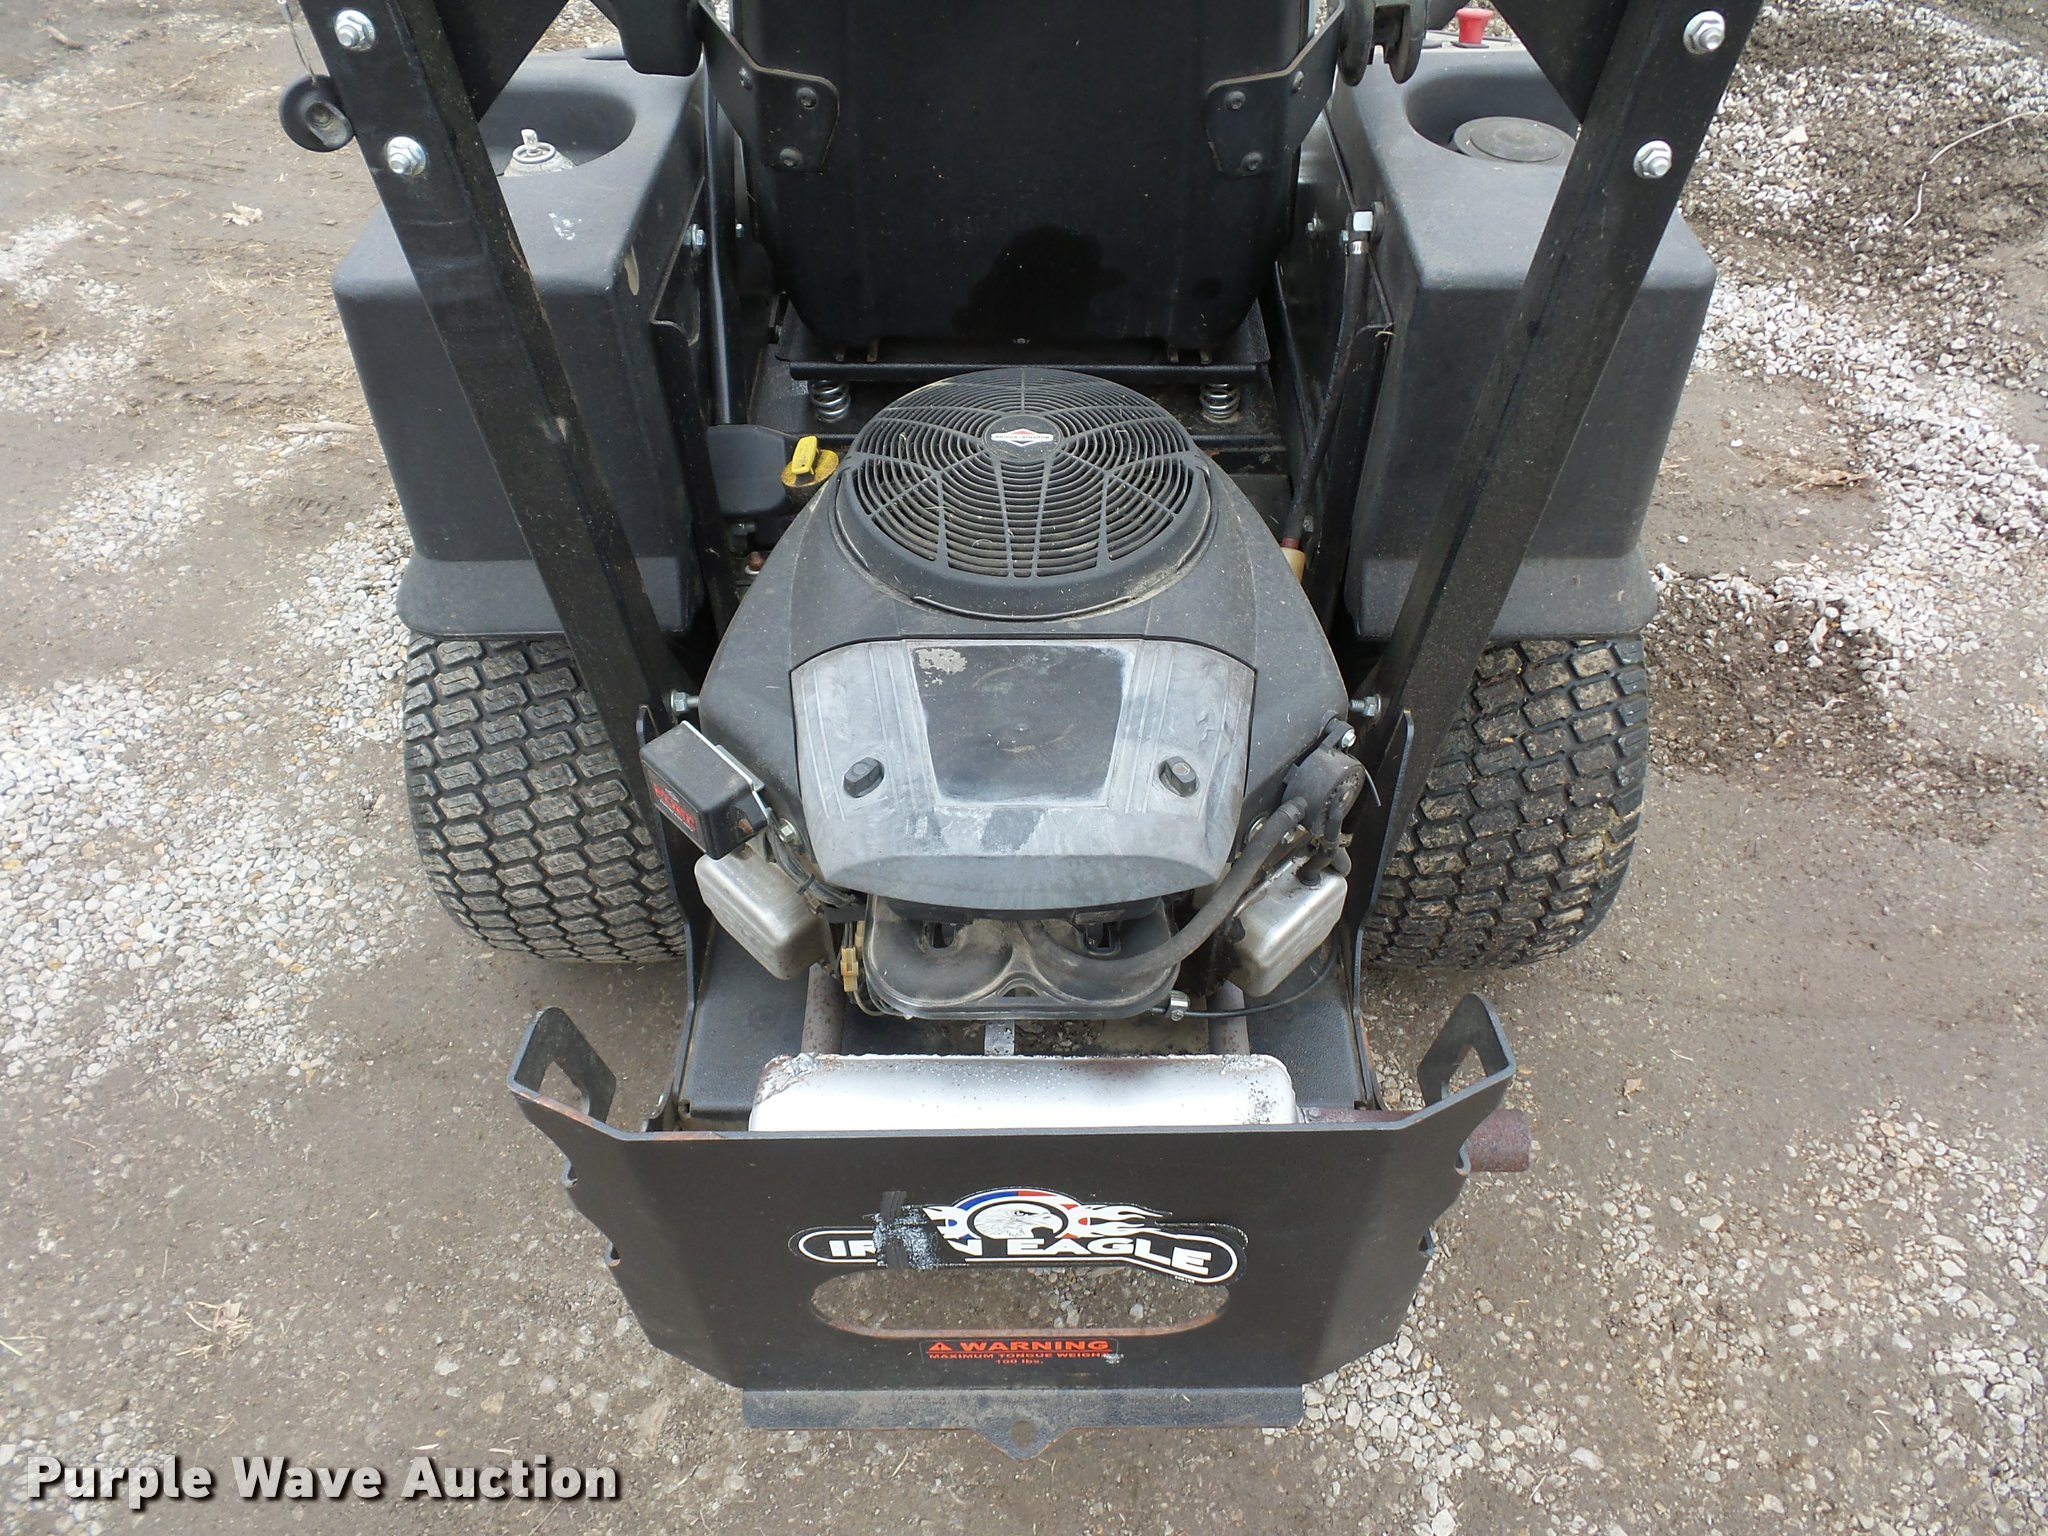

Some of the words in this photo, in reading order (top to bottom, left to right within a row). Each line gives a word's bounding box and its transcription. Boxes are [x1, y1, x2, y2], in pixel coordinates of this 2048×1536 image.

[829, 1239, 983, 1257] IRN
[1006, 1237, 1213, 1276] EAGLE
[959, 1340, 1110, 1351] WARNING
[928, 1352, 995, 1360] MAXIMUM
[1056, 1351, 1108, 1359] WEIGH
